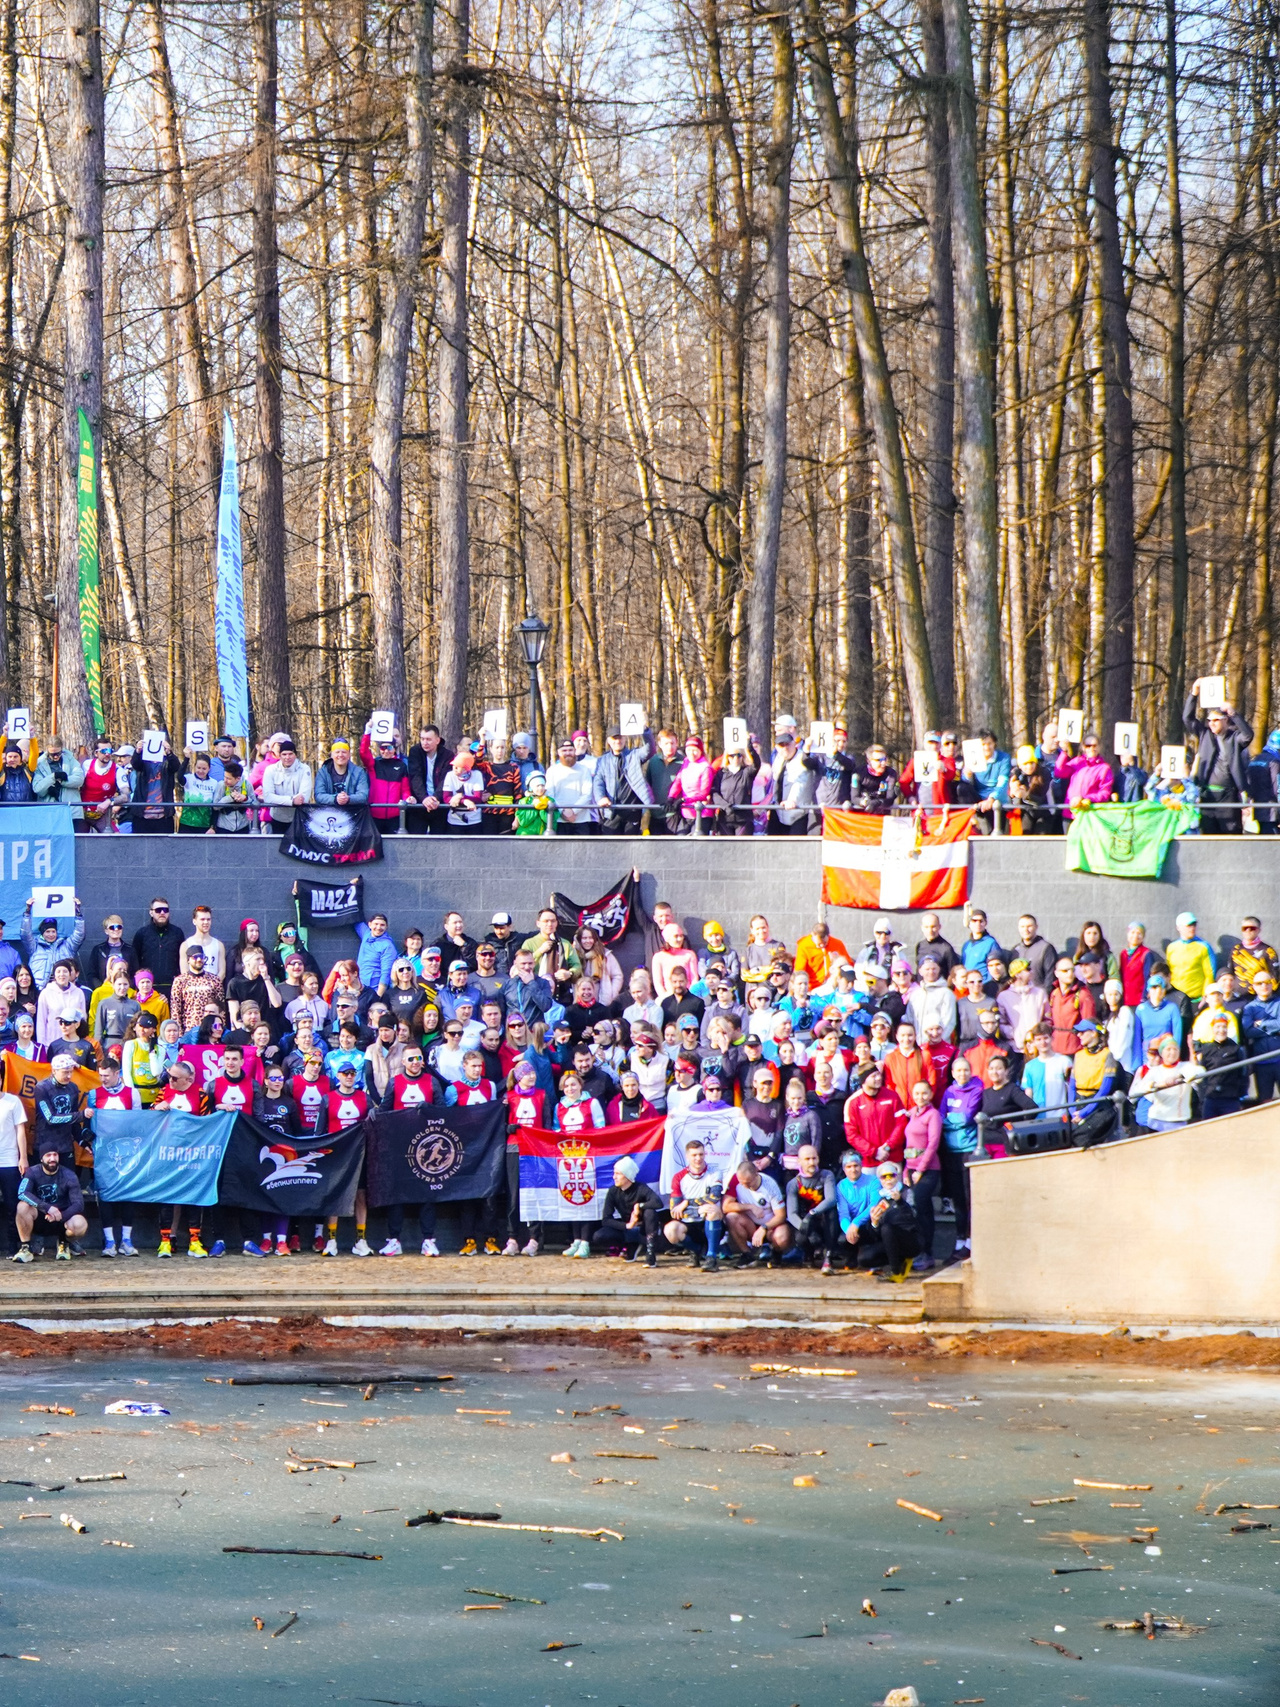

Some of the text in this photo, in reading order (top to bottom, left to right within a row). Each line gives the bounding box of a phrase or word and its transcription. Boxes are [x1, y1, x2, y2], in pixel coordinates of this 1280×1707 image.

[13, 716, 27, 733] R
[375, 719, 390, 735] S
[623, 712, 638, 728] A
[190, 730, 205, 746] S
[146, 738, 163, 755] U
[288, 843, 330, 863] ГУМУС
[45, 893, 64, 909] P
[311, 885, 358, 910] M42.2
[204, 955, 215, 966] 2.2
[411, 1126, 459, 1144] GOLDEN RING
[159, 1145, 222, 1161] КАПИБАРА
[412, 1164, 461, 1183] ULTRA TRAIL
[430, 1183, 443, 1191] 100
